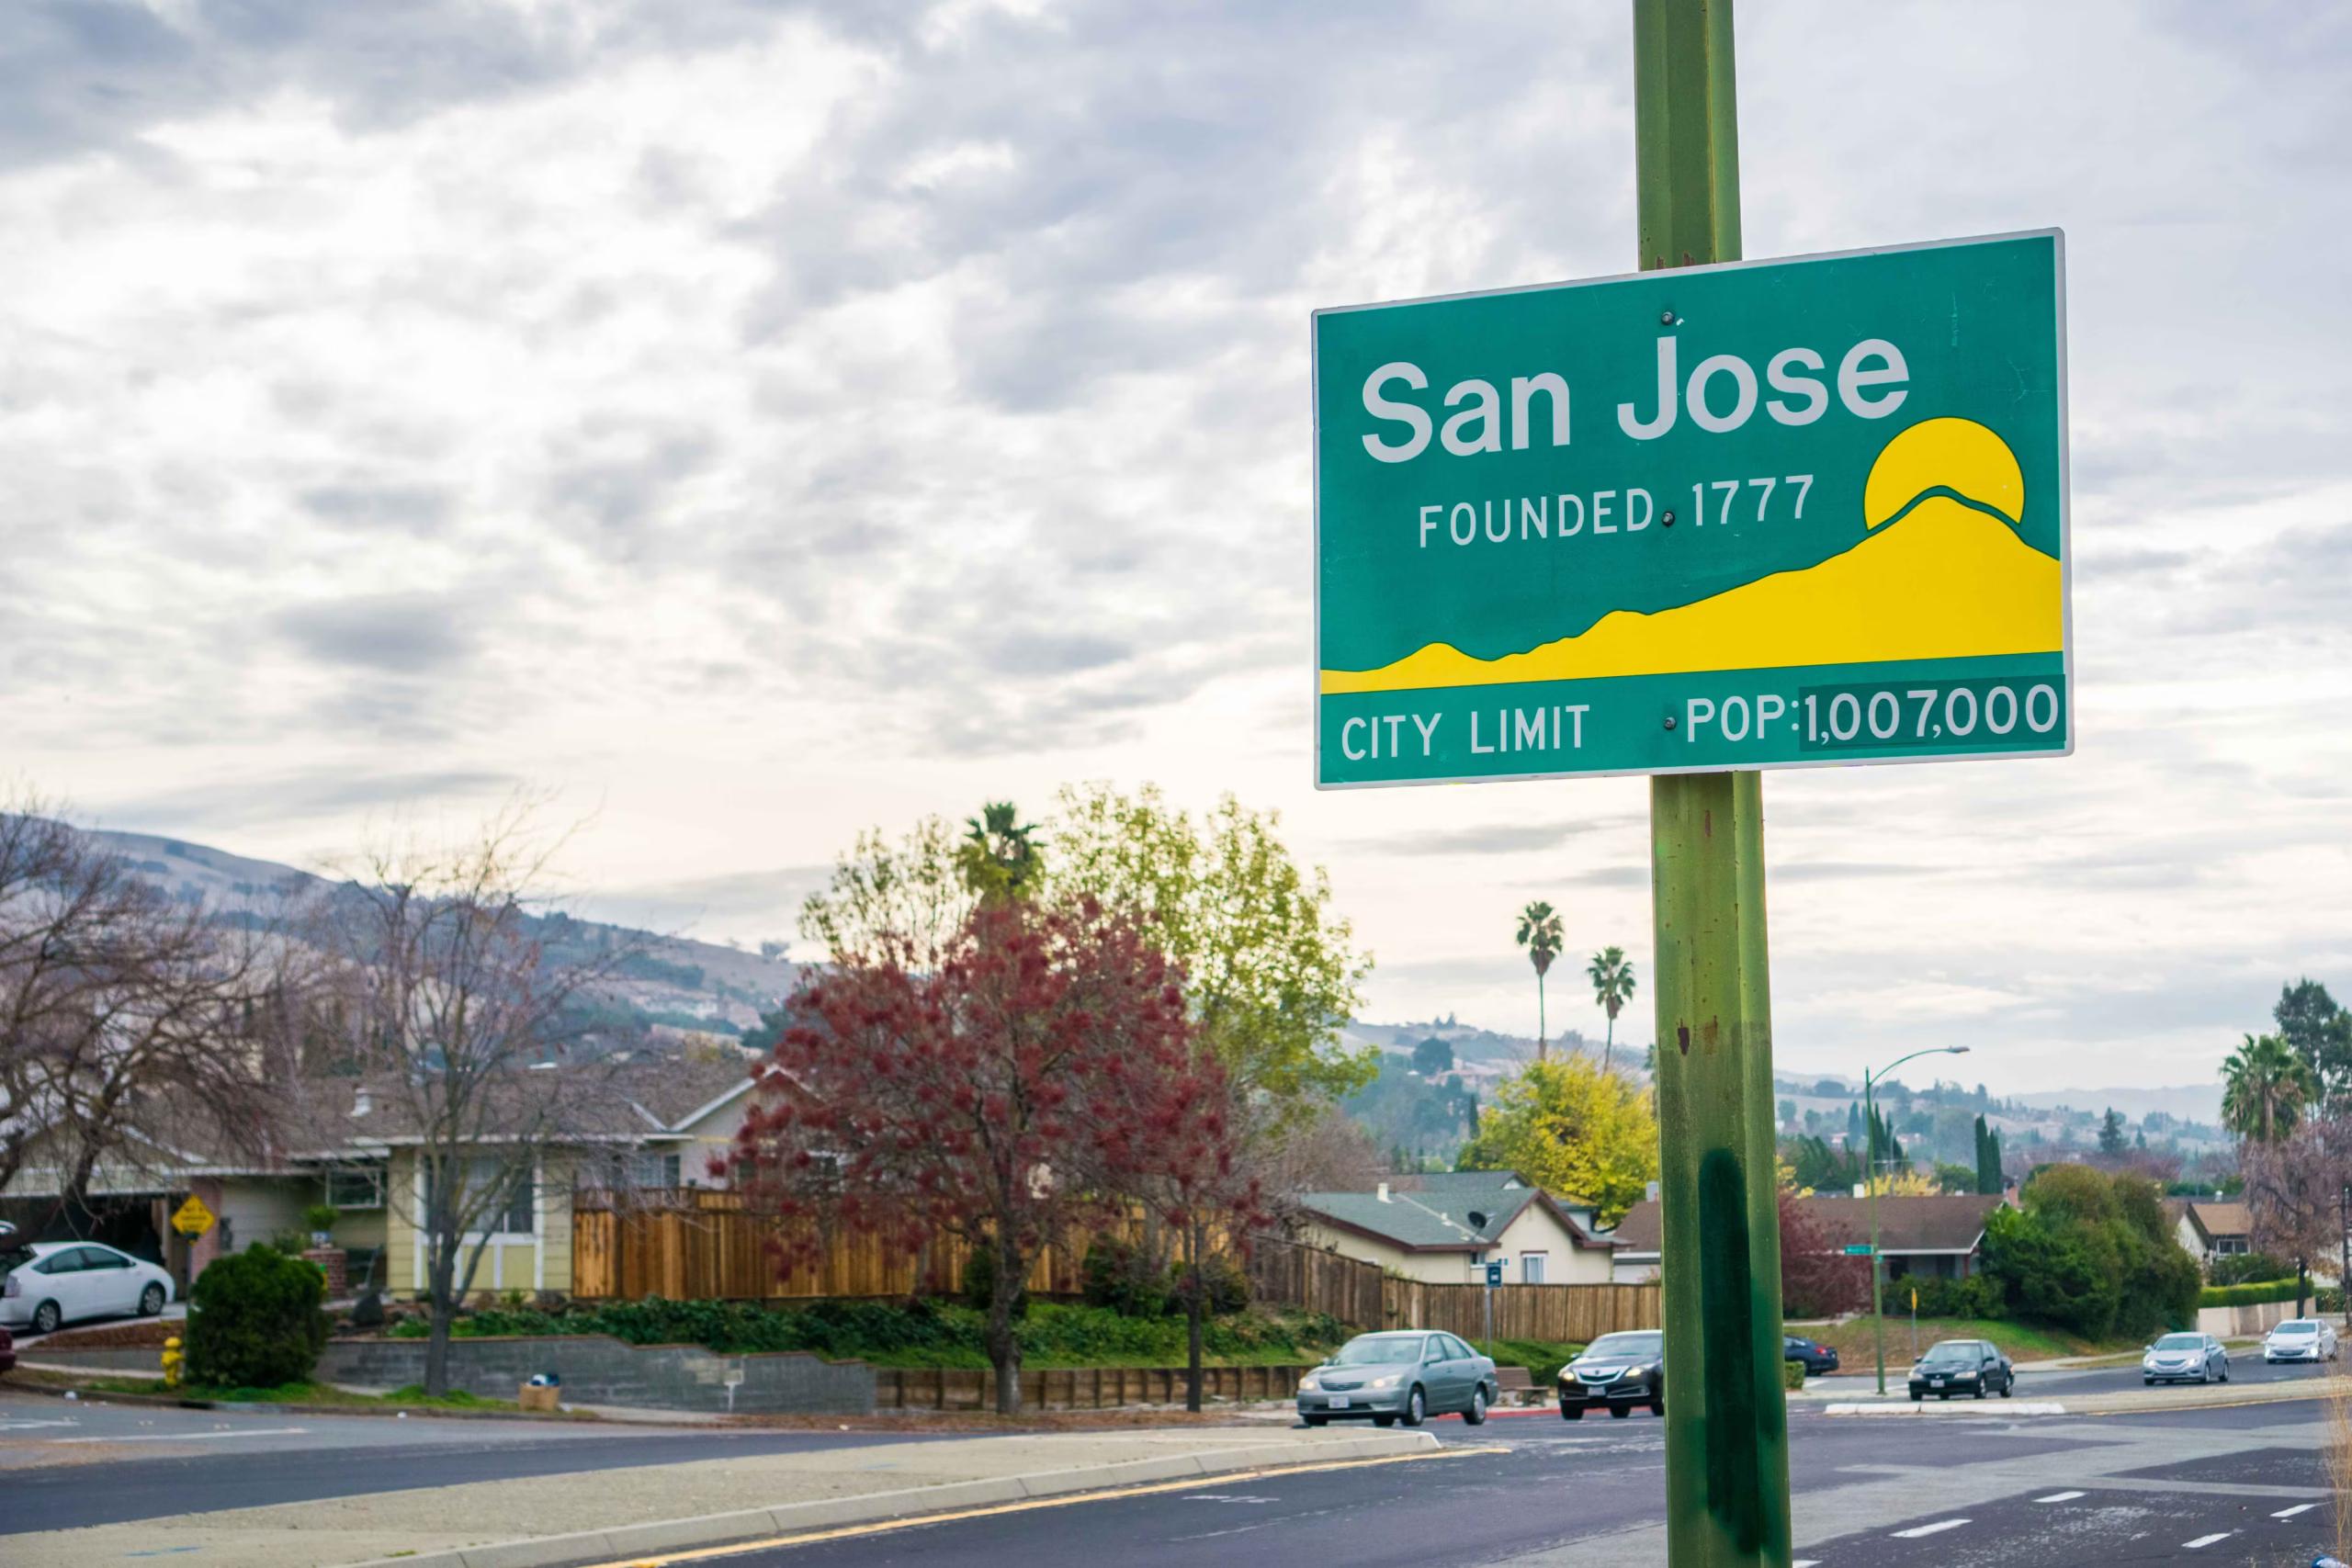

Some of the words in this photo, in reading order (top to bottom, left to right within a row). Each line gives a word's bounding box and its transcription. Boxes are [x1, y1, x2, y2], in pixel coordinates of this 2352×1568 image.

[1362, 361, 1571, 463] San
[1617, 336, 1910, 440] Jose
[1419, 488, 1653, 547] FOUNDED
[1692, 474, 1814, 526] 1777
[1341, 713, 1442, 761] CITY
[1471, 705, 1589, 754] LIMIT
